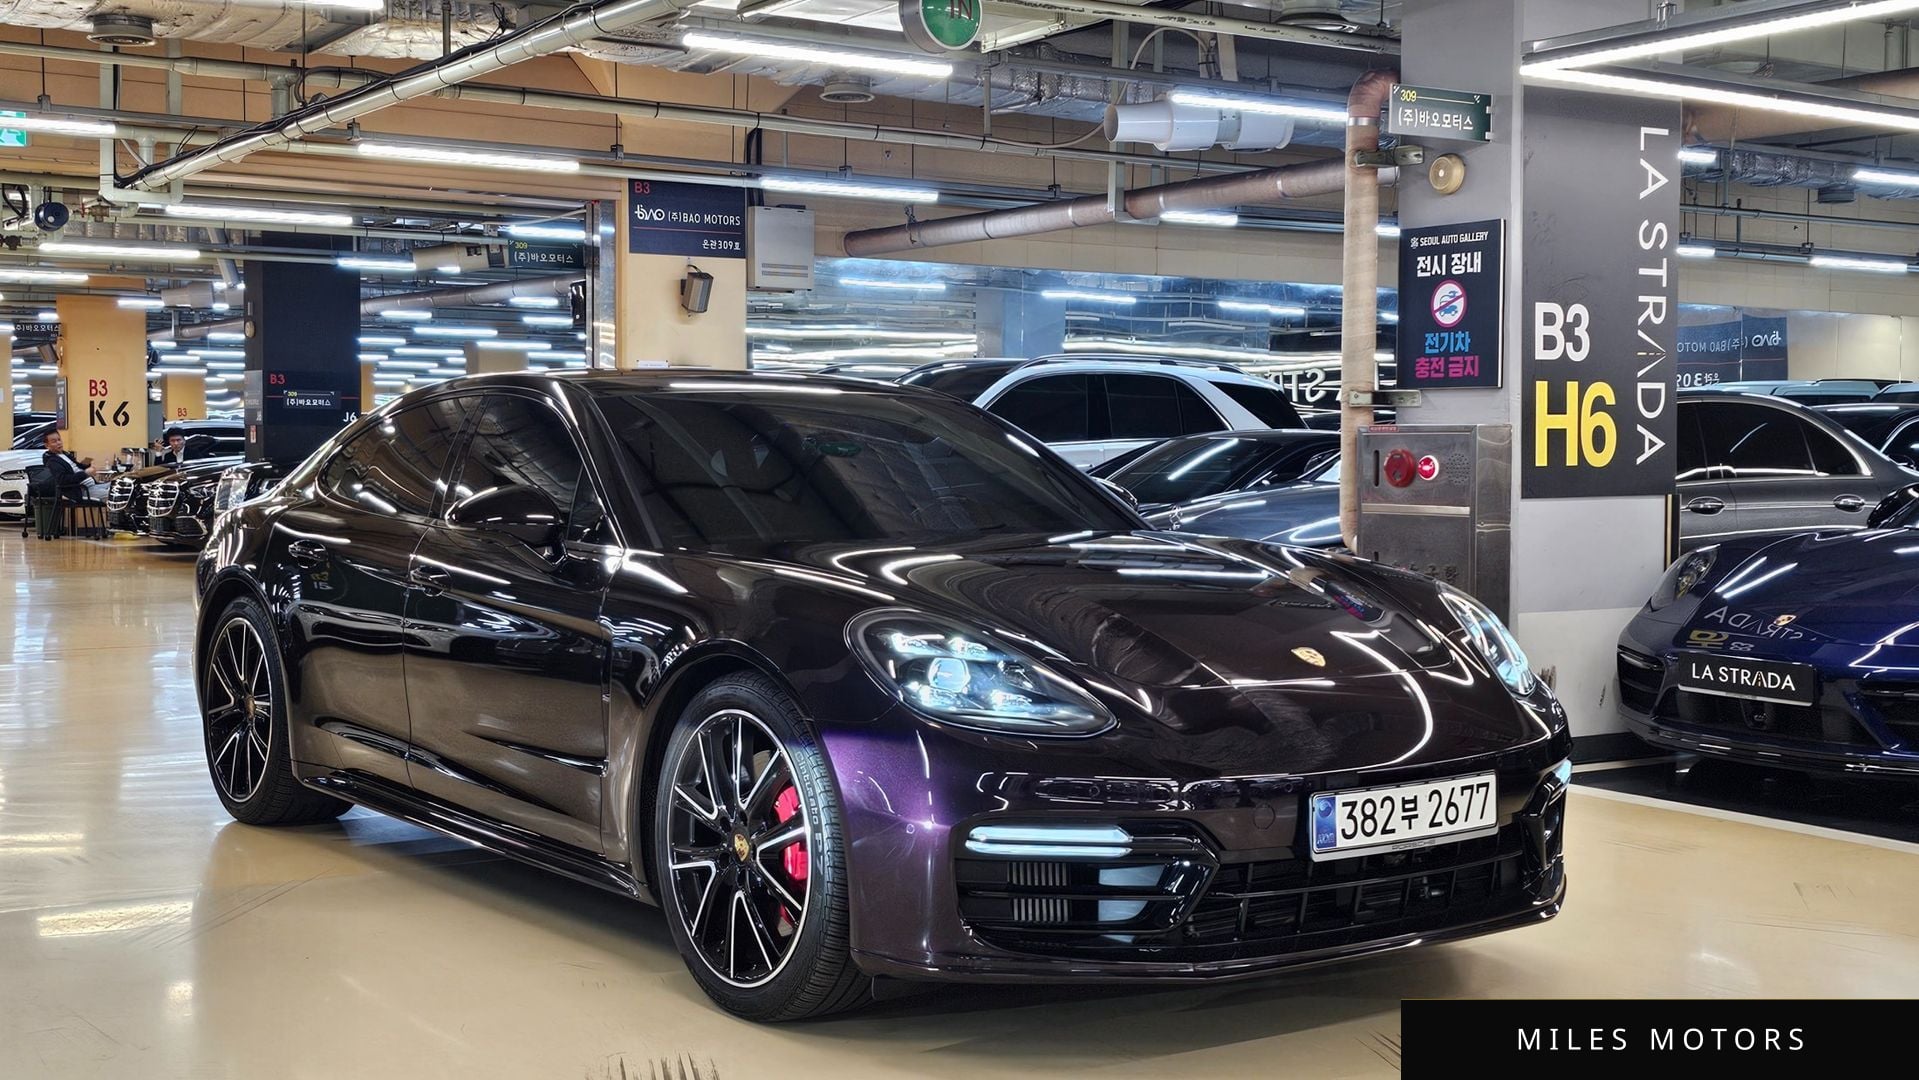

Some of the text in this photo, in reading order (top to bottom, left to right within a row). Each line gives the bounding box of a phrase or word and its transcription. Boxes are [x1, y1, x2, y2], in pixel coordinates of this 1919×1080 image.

[1400, 89, 1417, 102] 309
[1398, 106, 1474, 131] (주)바오모터스
[634, 181, 650, 194] B3
[704, 214, 741, 226] MOTORS
[514, 241, 528, 249] 309
[1419, 231, 1489, 247] SEOUL AUTO GALLERY
[514, 251, 574, 263] (주)바오모터스
[1416, 250, 1482, 278] 전시 장내
[1636, 126, 1670, 465] LA STRADA
[1534, 301, 1591, 362] B3
[1424, 330, 1472, 354] 전기차
[1415, 355, 1479, 379] 충전 금지
[89, 379, 108, 397] B3
[270, 374, 286, 385] B3
[177, 407, 187, 417] B3
[342, 411, 357, 423] J6
[1534, 380, 1617, 468] H6
[1691, 662, 1796, 692] LA STRADA
[1340, 781, 1490, 840] 382부 2677
